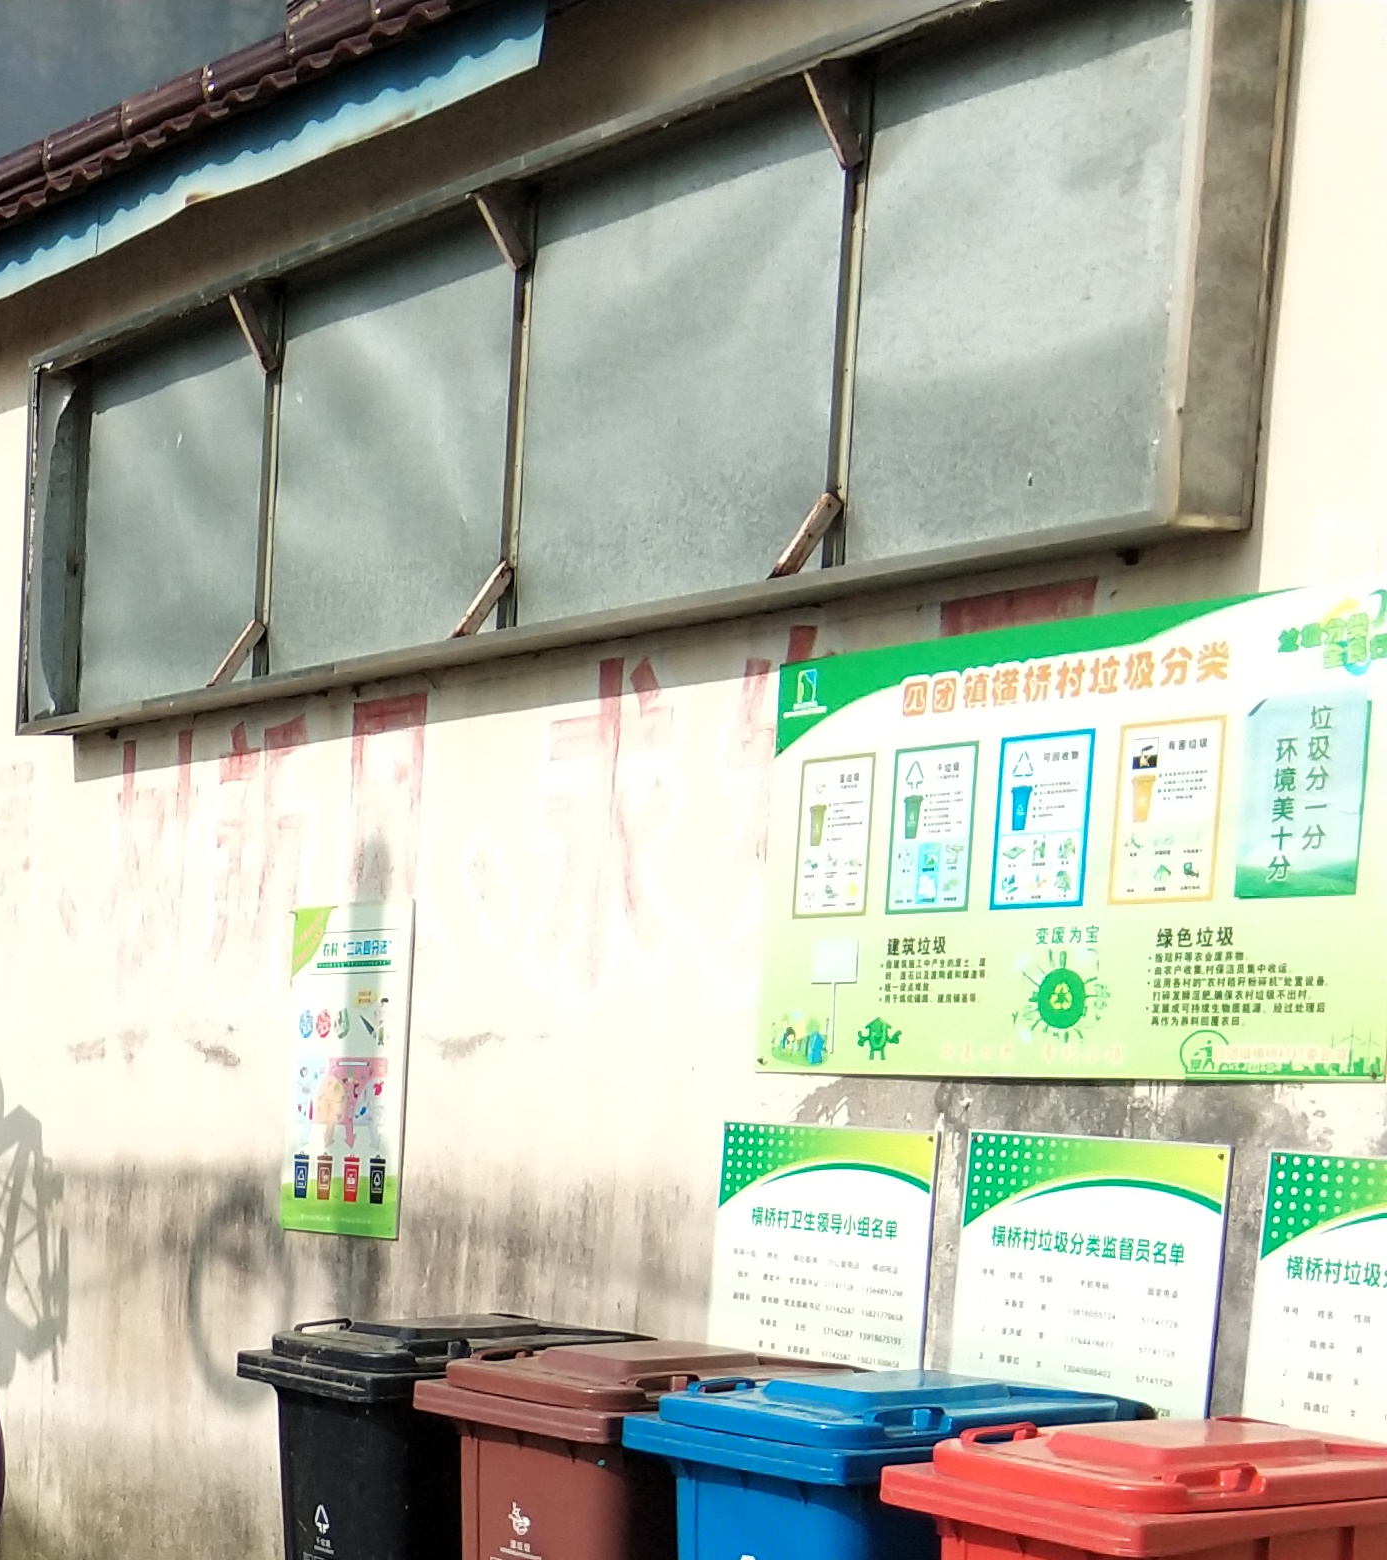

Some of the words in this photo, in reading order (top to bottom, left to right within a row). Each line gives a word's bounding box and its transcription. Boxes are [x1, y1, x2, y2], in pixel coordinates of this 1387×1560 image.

[902, 642, 1229, 717] 四团镇横桥村垃圾分类
[1302, 705, 1332, 850] 垃圾分一分
[1268, 737, 1299, 881] 环境美十分
[886, 935, 947, 956] 建筑垃圾
[1036, 925, 1100, 945] 变废为宝
[1156, 926, 1234, 948] 绿色垃圾
[751, 1206, 898, 1240] 横桥村卫生领导小组名单
[992, 1225, 1185, 1266] 横桥村垃圾分类监督员名单
